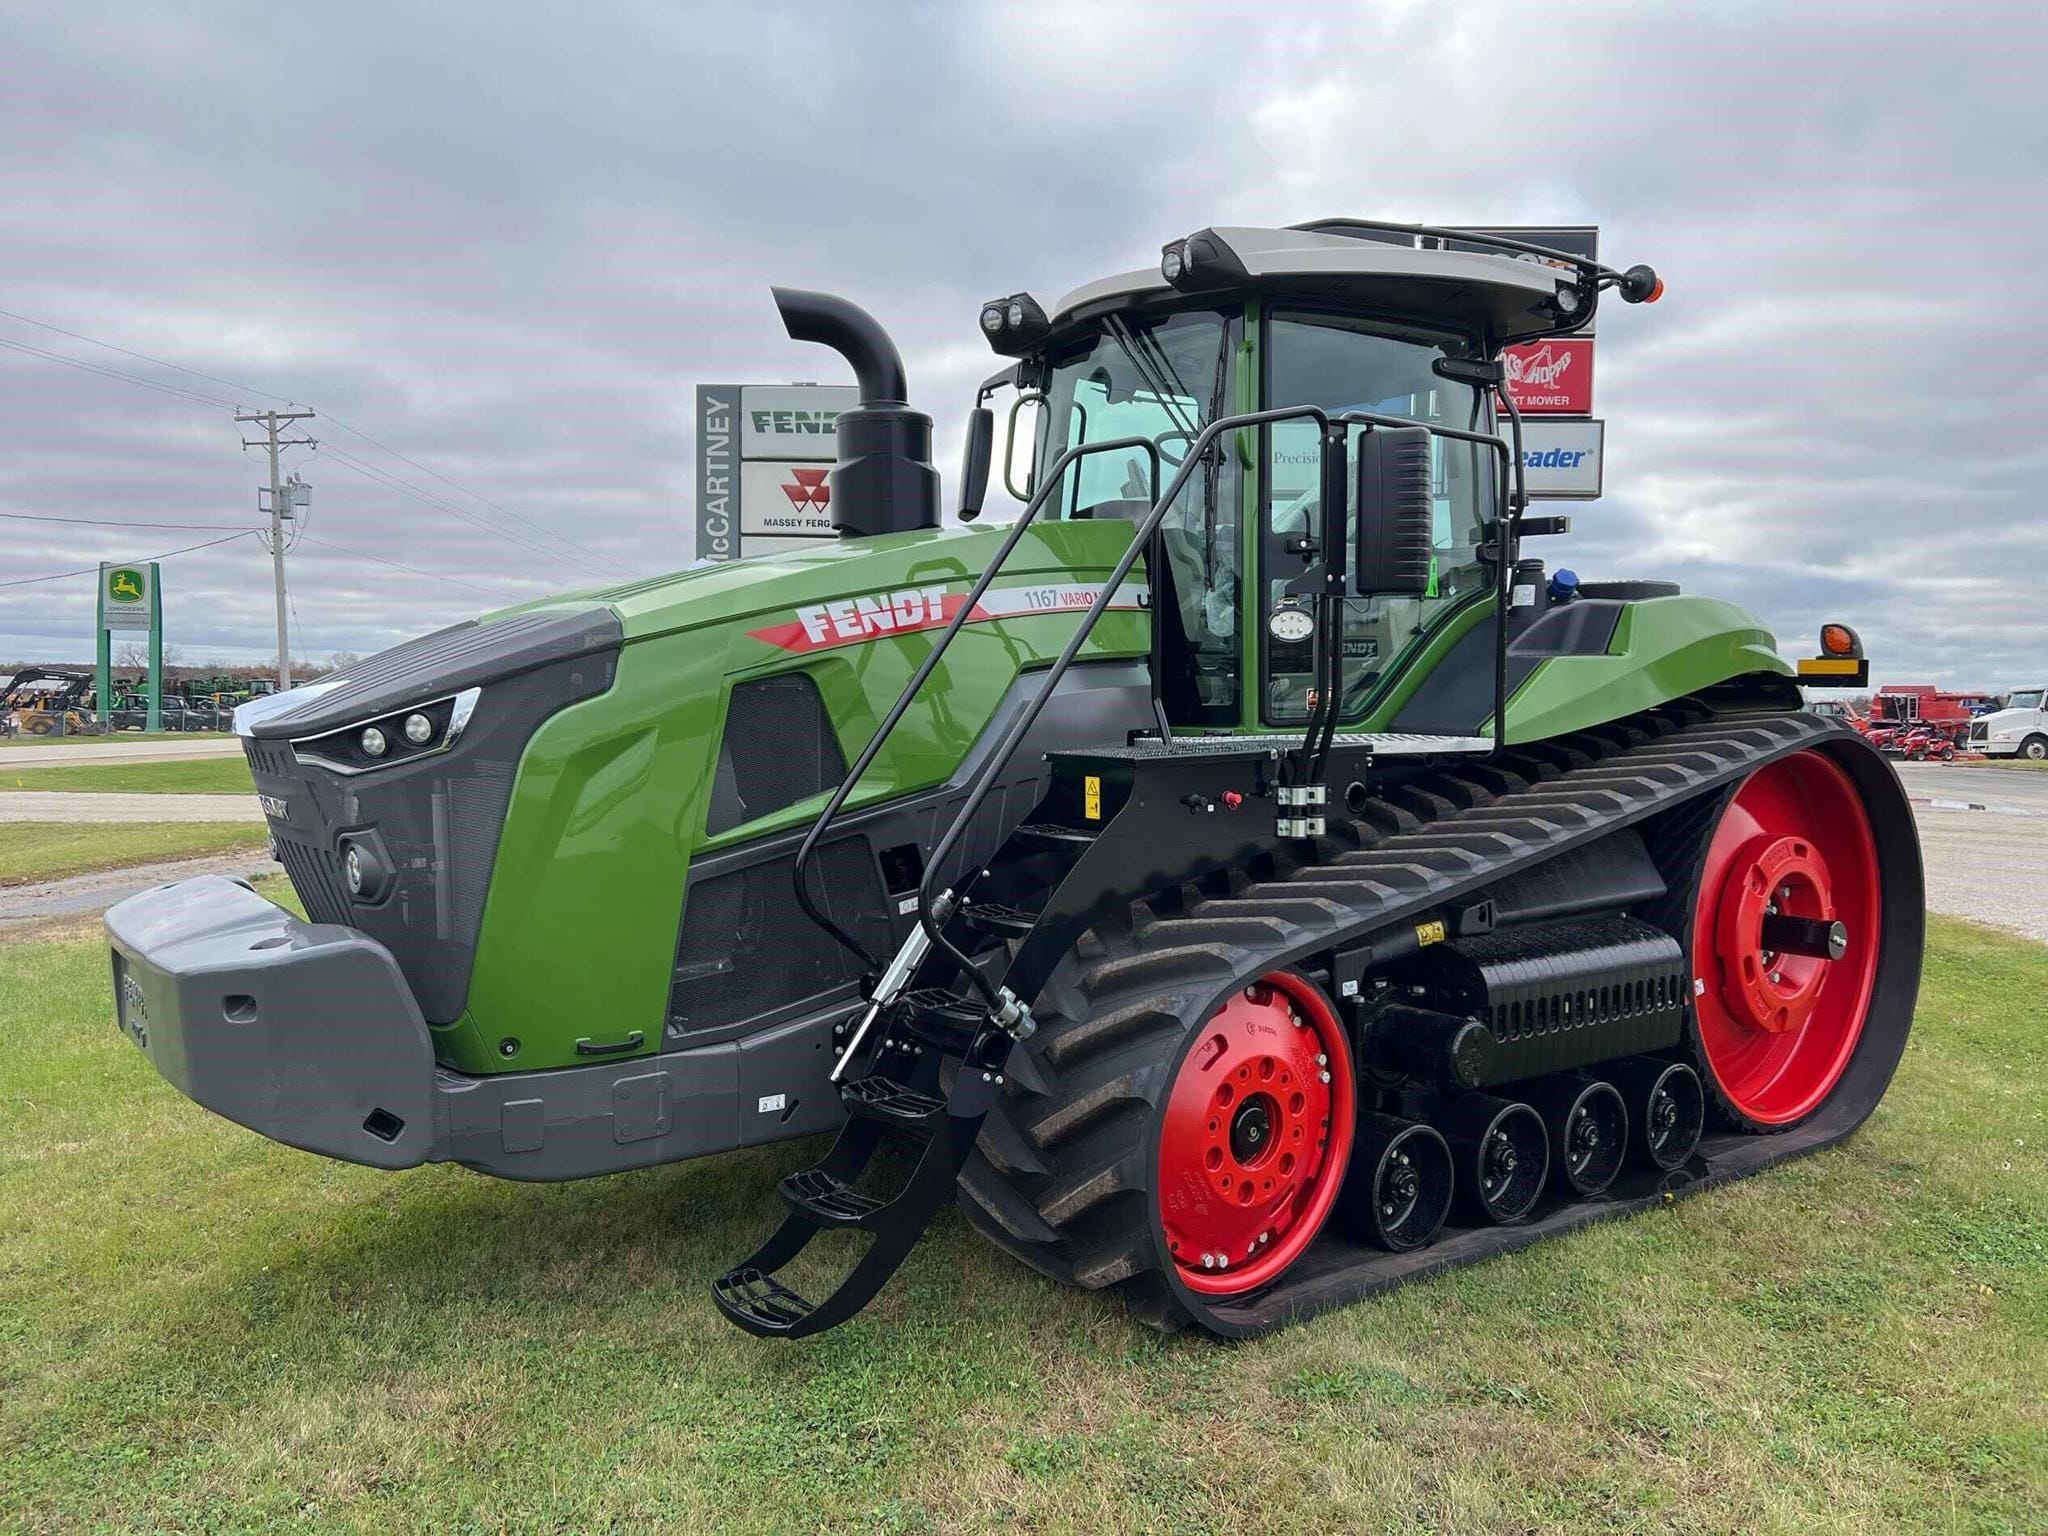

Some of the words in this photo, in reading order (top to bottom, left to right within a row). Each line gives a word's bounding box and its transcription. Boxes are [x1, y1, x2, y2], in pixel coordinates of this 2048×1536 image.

[1527, 396, 1570, 405] MOWER
[706, 396, 729, 560] cCARTNEY
[763, 518, 802, 528] MASSEY
[795, 585, 947, 644] FENDT
[1025, 589, 1058, 609] 1167
[1060, 591, 1093, 606] VARIO
